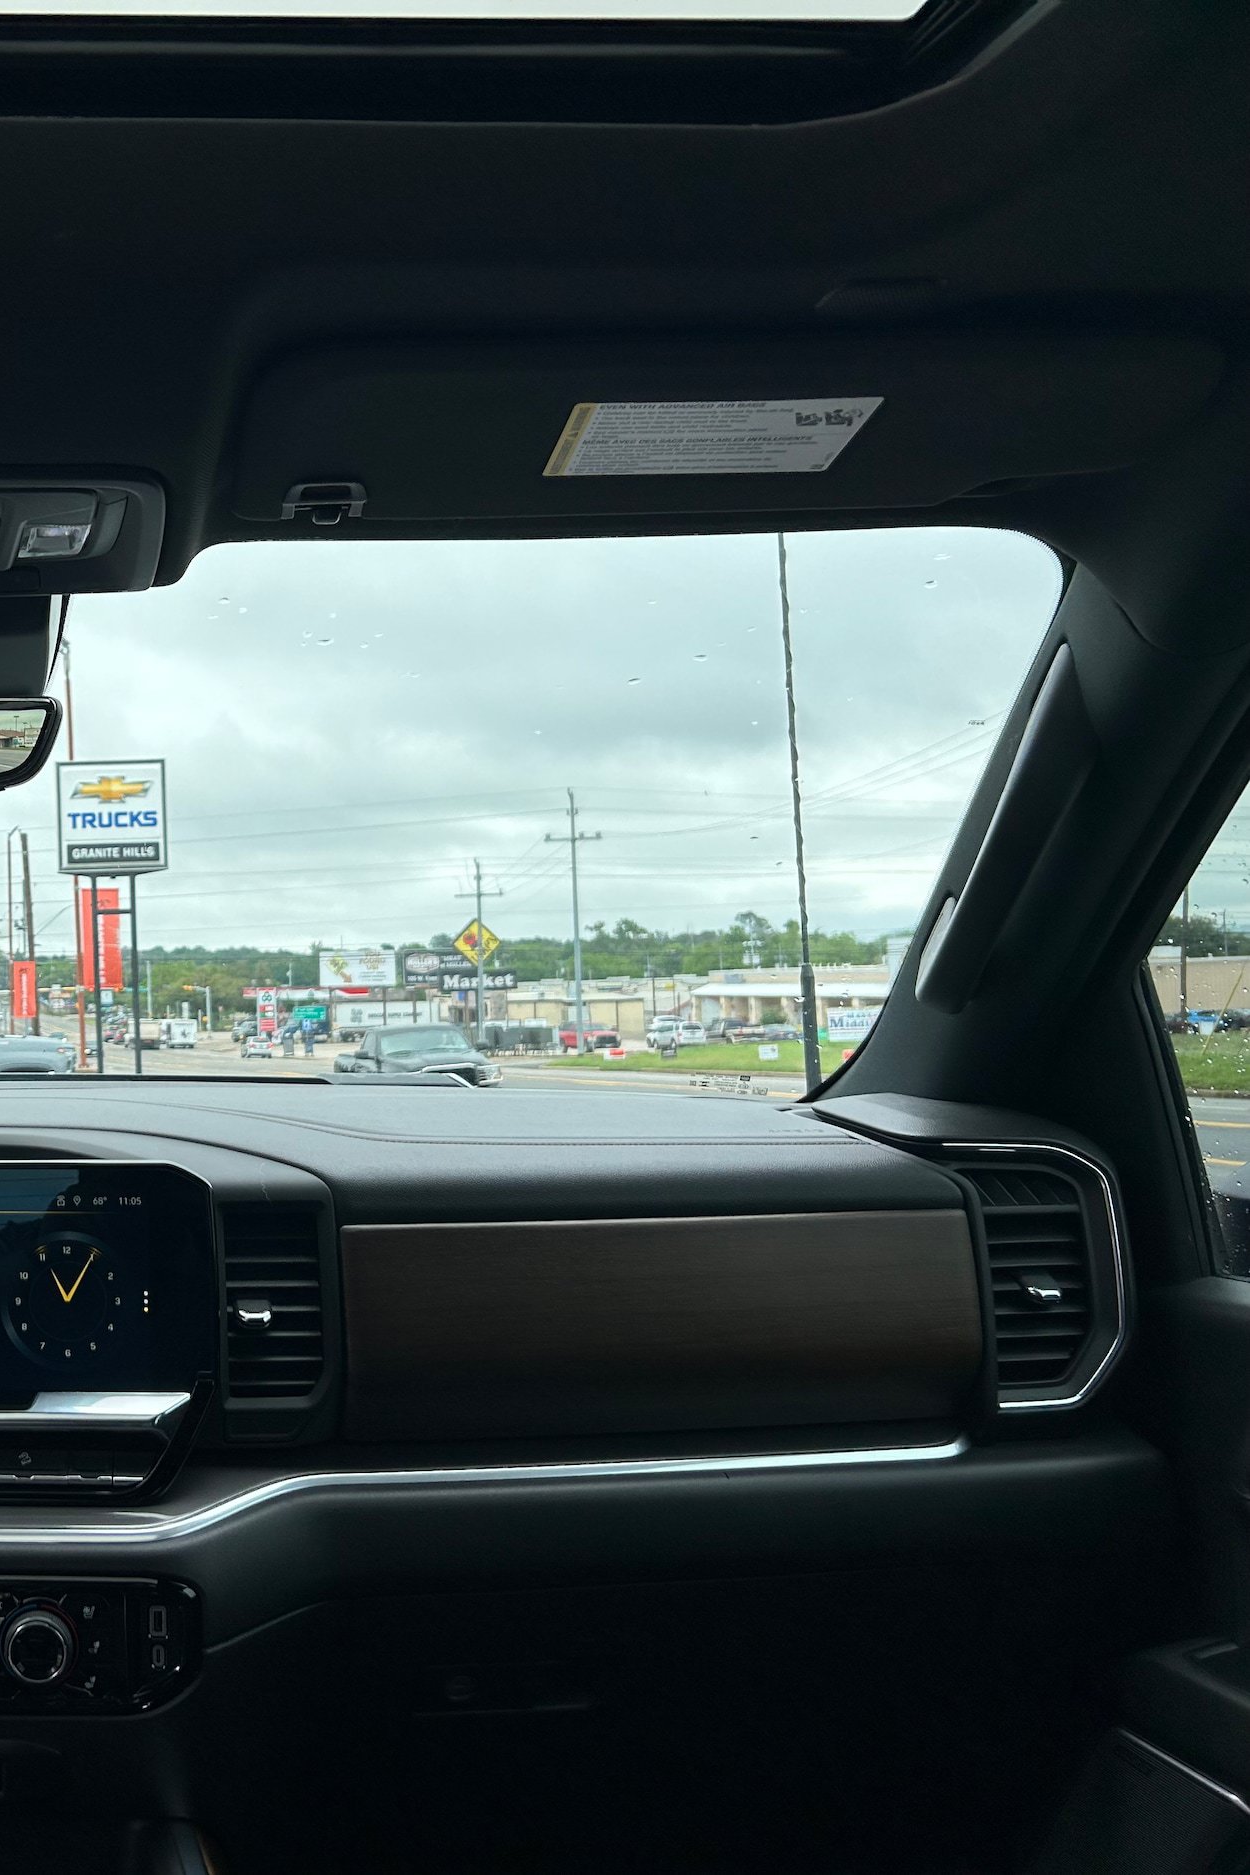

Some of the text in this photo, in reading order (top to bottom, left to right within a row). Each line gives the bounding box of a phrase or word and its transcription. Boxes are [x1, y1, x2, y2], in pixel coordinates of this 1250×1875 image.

[67, 811, 158, 829] TRUCKS
[72, 845, 155, 860] GRANITE HILLS
[443, 973, 514, 990] Market
[118, 1196, 142, 1206] 11:05
[62, 1246, 71, 1254] 12
[19, 1272, 29, 1280] 10
